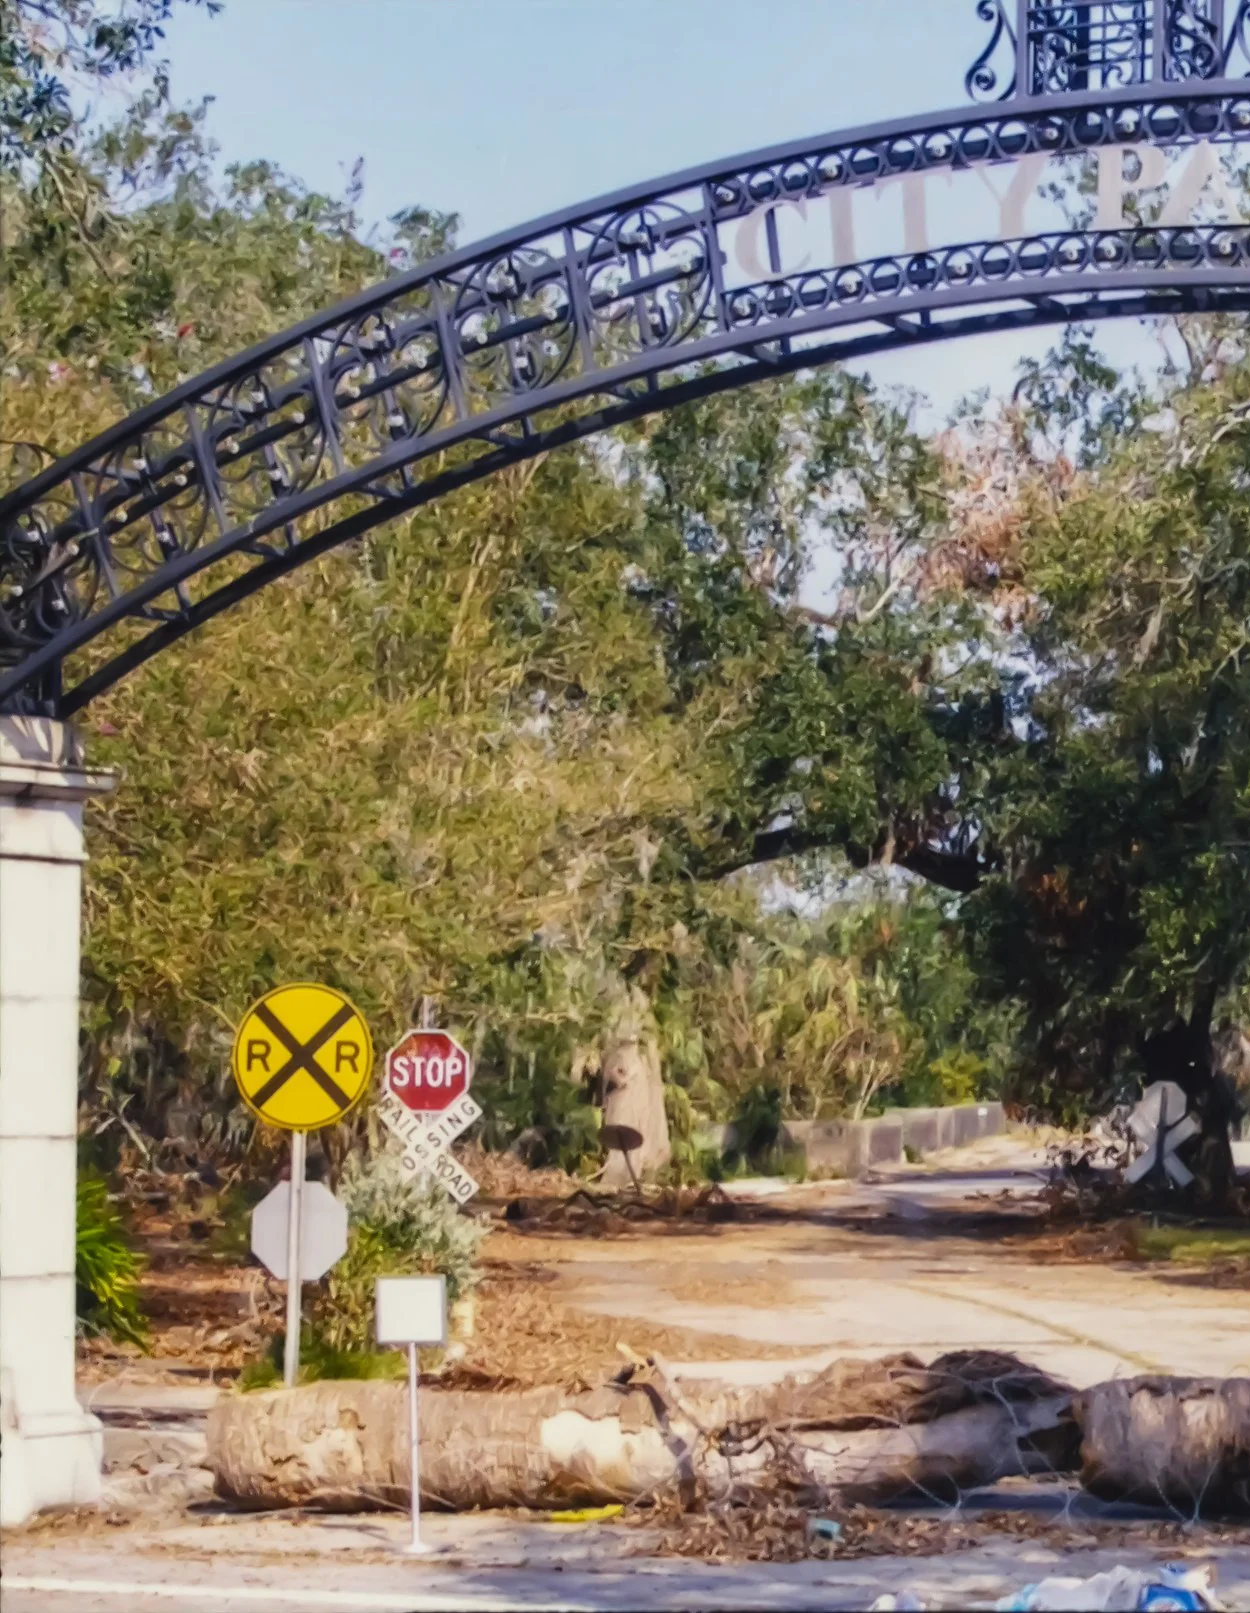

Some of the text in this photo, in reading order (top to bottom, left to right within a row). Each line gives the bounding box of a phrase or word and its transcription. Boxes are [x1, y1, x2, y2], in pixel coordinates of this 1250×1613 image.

[733, 151, 1048, 283] CITY
[246, 1040, 271, 1072] R
[335, 1041, 360, 1073] R
[392, 1056, 463, 1087] STOP
